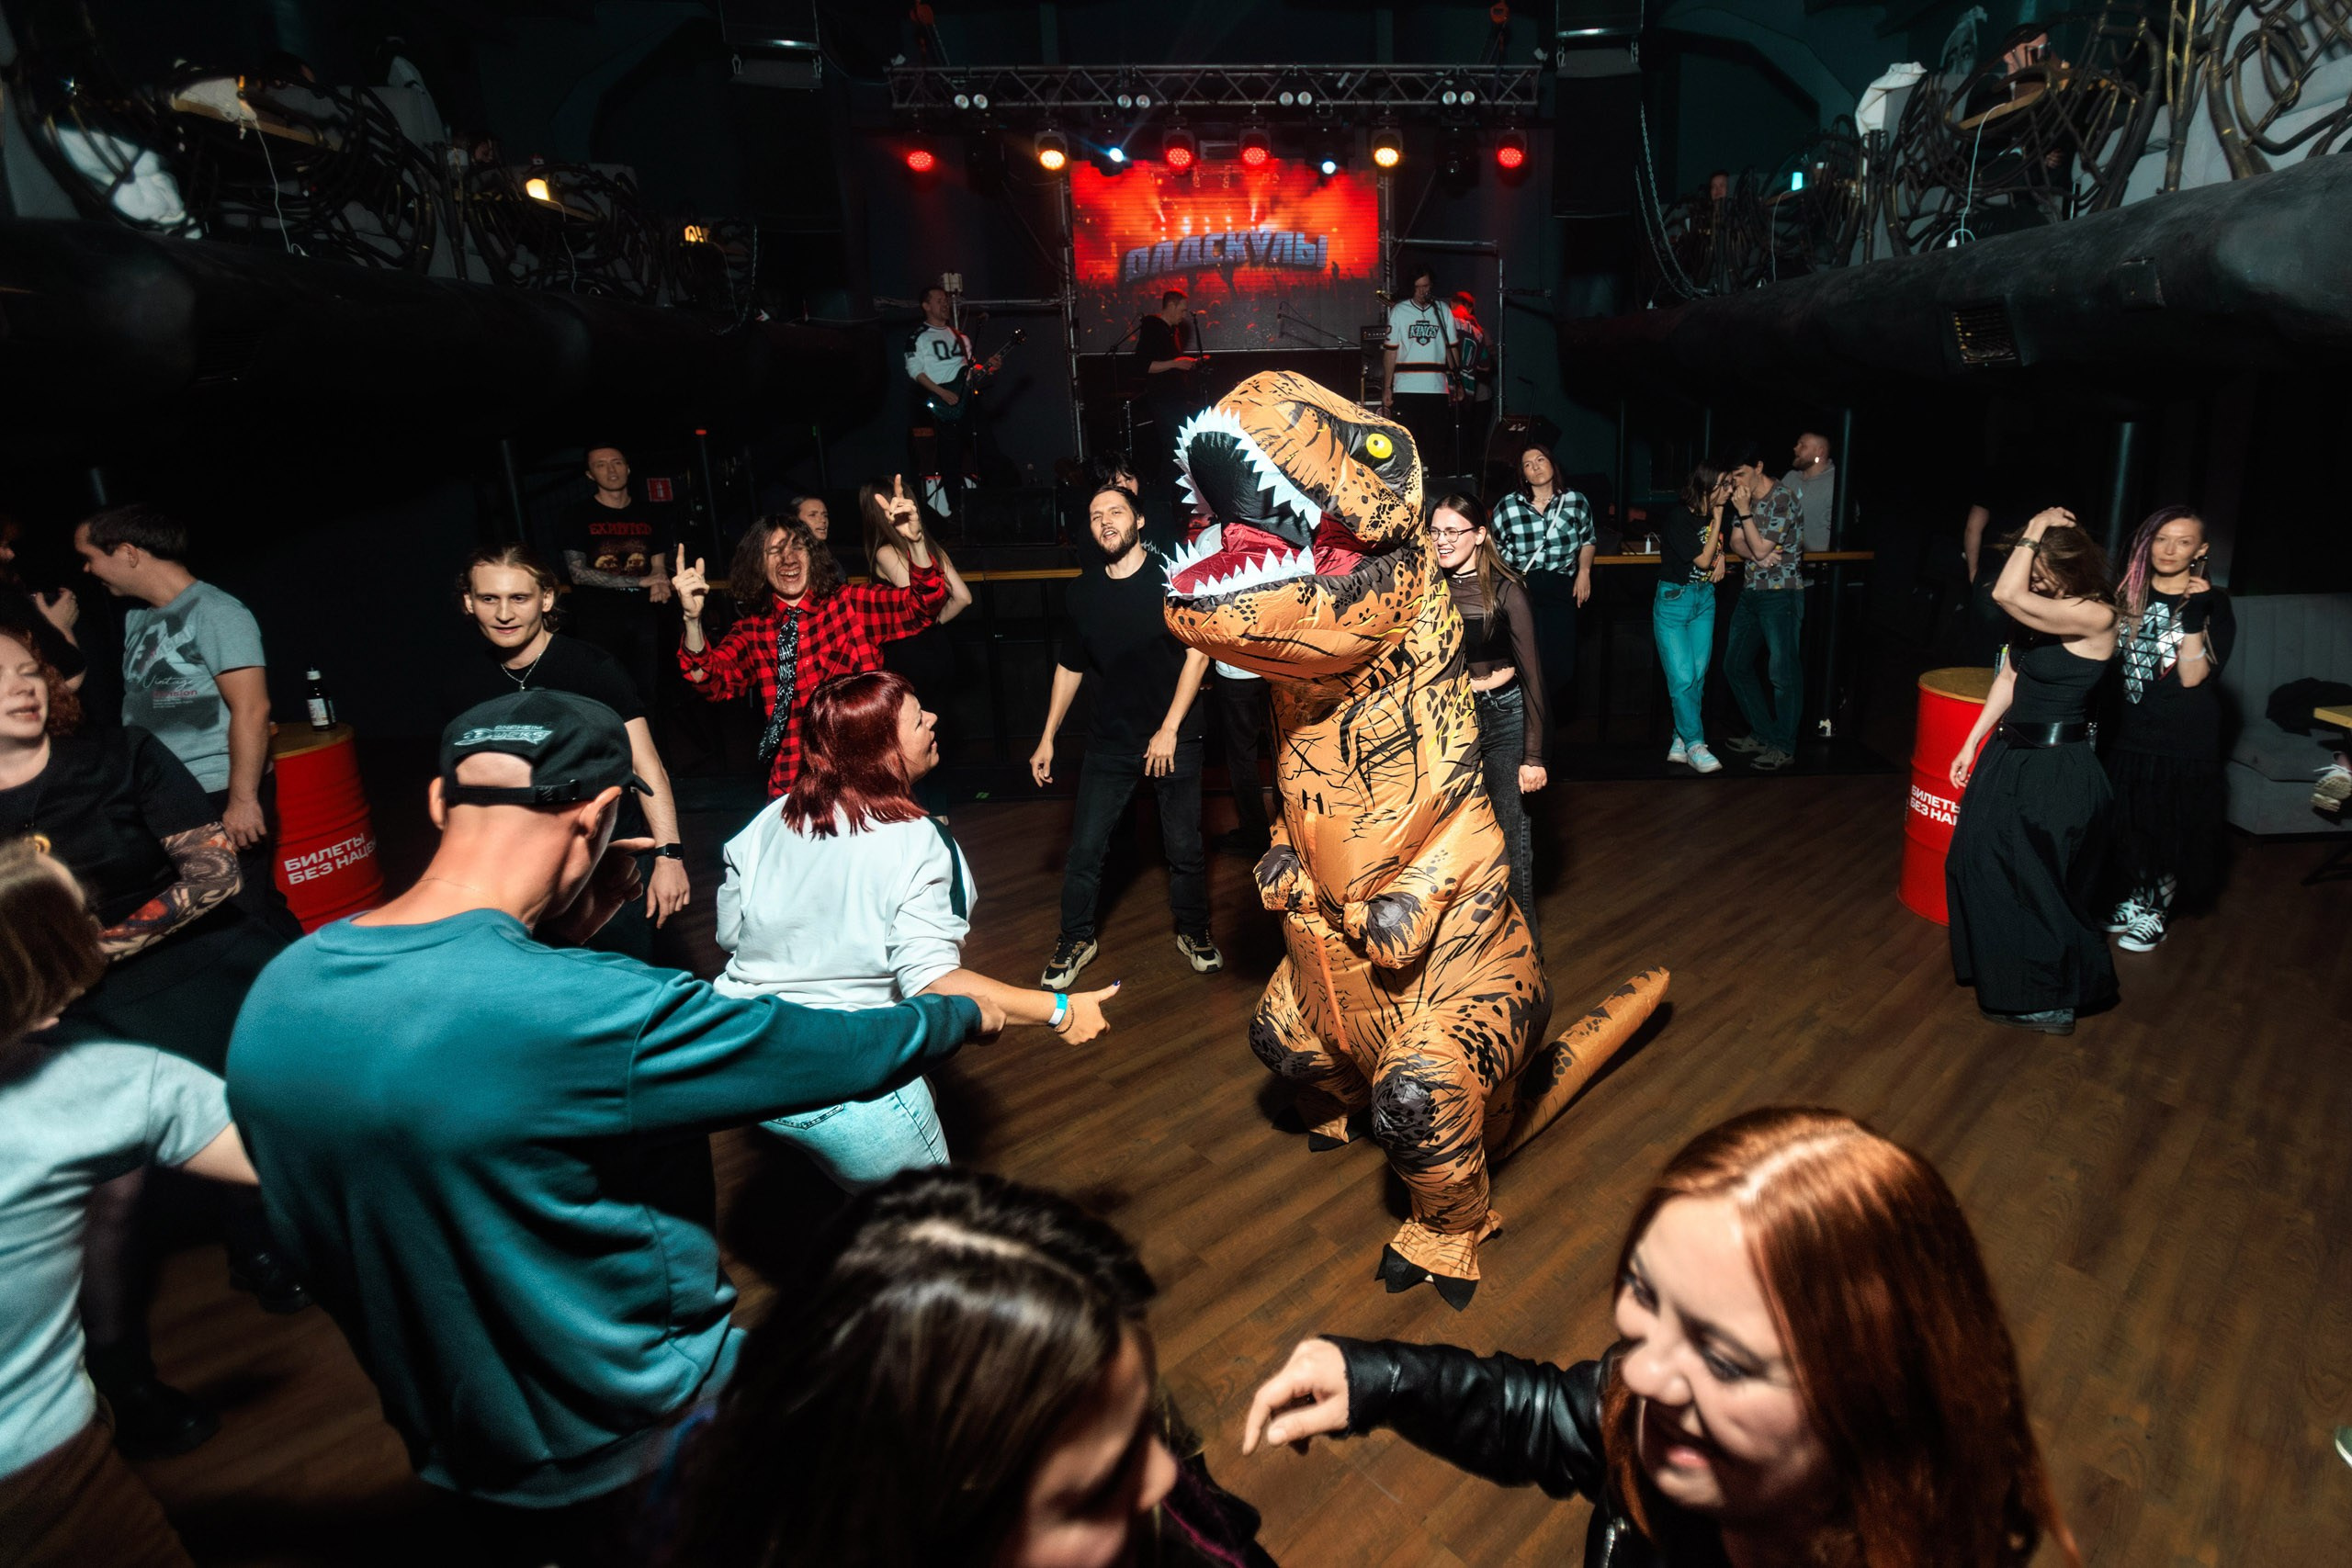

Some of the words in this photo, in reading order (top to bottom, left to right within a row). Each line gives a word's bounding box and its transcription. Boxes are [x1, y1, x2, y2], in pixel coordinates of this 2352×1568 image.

[1409, 324, 1440, 338] KINGS
[1910, 796, 1929, 817] БЕЗ
[1930, 807, 1958, 826] НА
[284, 832, 365, 872] БИЛЕТЫ
[288, 862, 334, 886] БЕЗ
